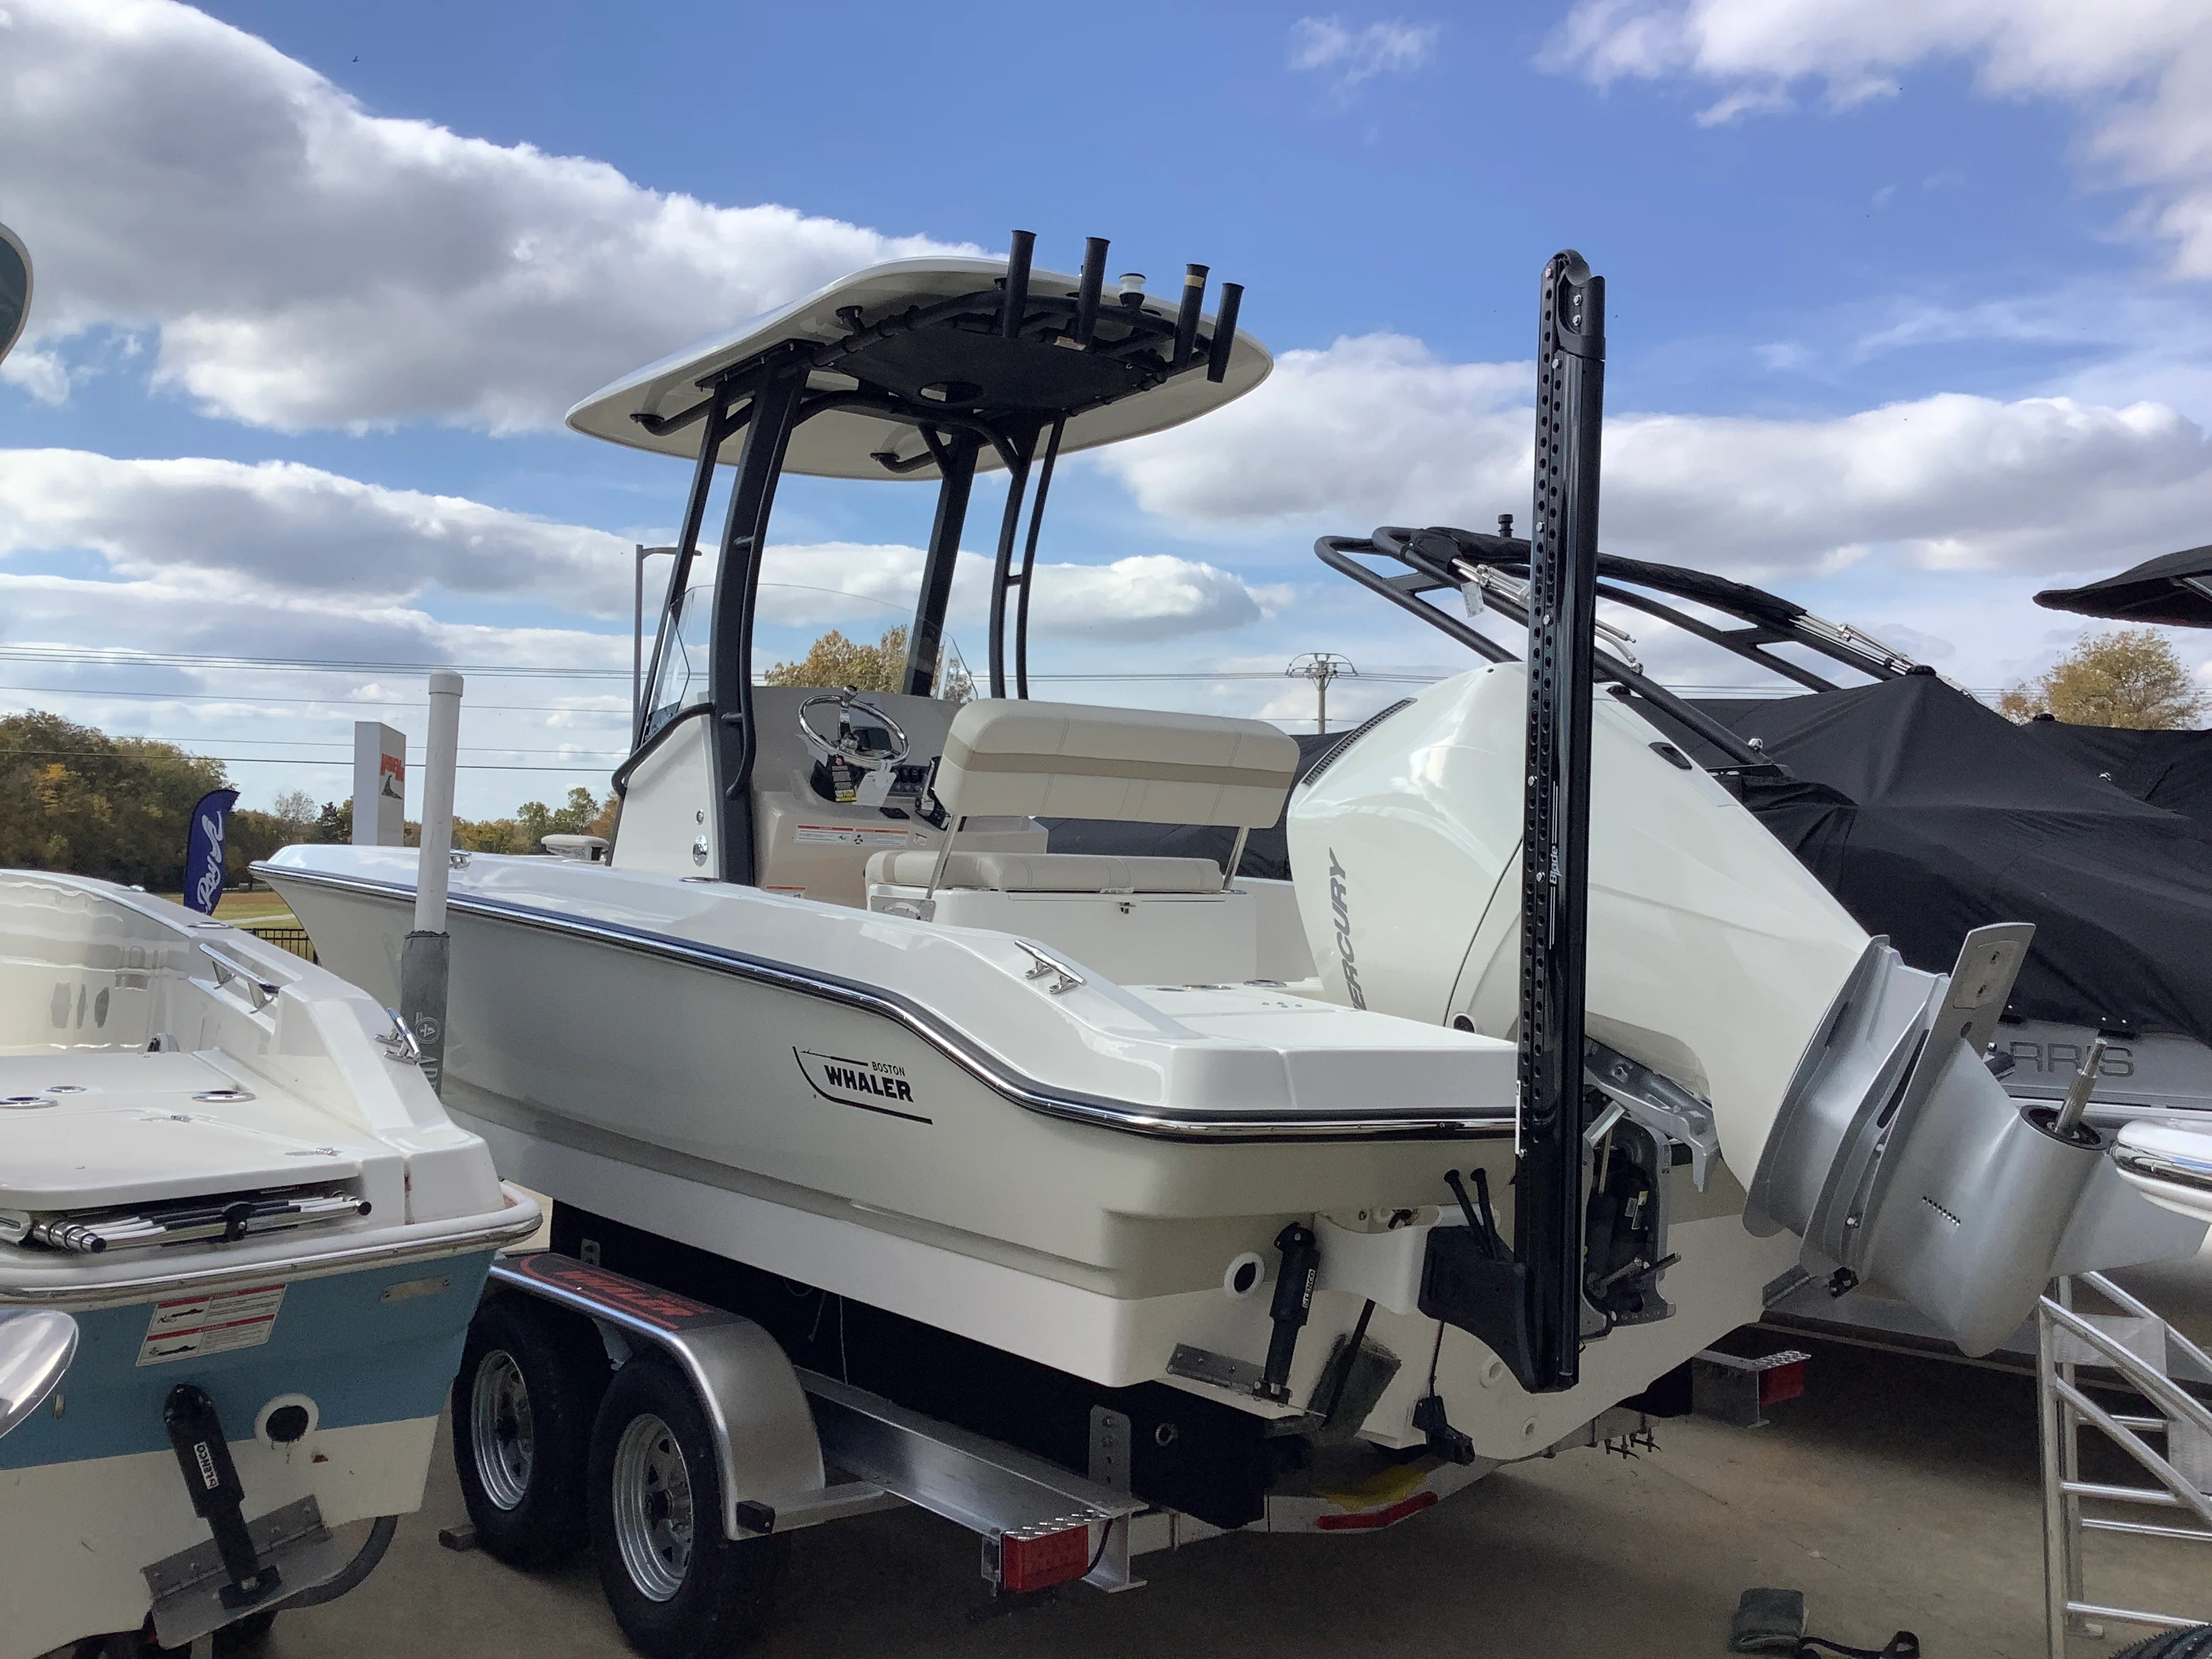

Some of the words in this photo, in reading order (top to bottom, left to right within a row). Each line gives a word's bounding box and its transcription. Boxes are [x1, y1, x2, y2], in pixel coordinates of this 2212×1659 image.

[1549, 845, 1562, 884] Blade
[1329, 847, 1367, 1010] ERCURY
[824, 1065, 914, 1103] WHALER
[872, 1061, 905, 1077] BOSTON
[197, 1444, 214, 1479] LENCO
